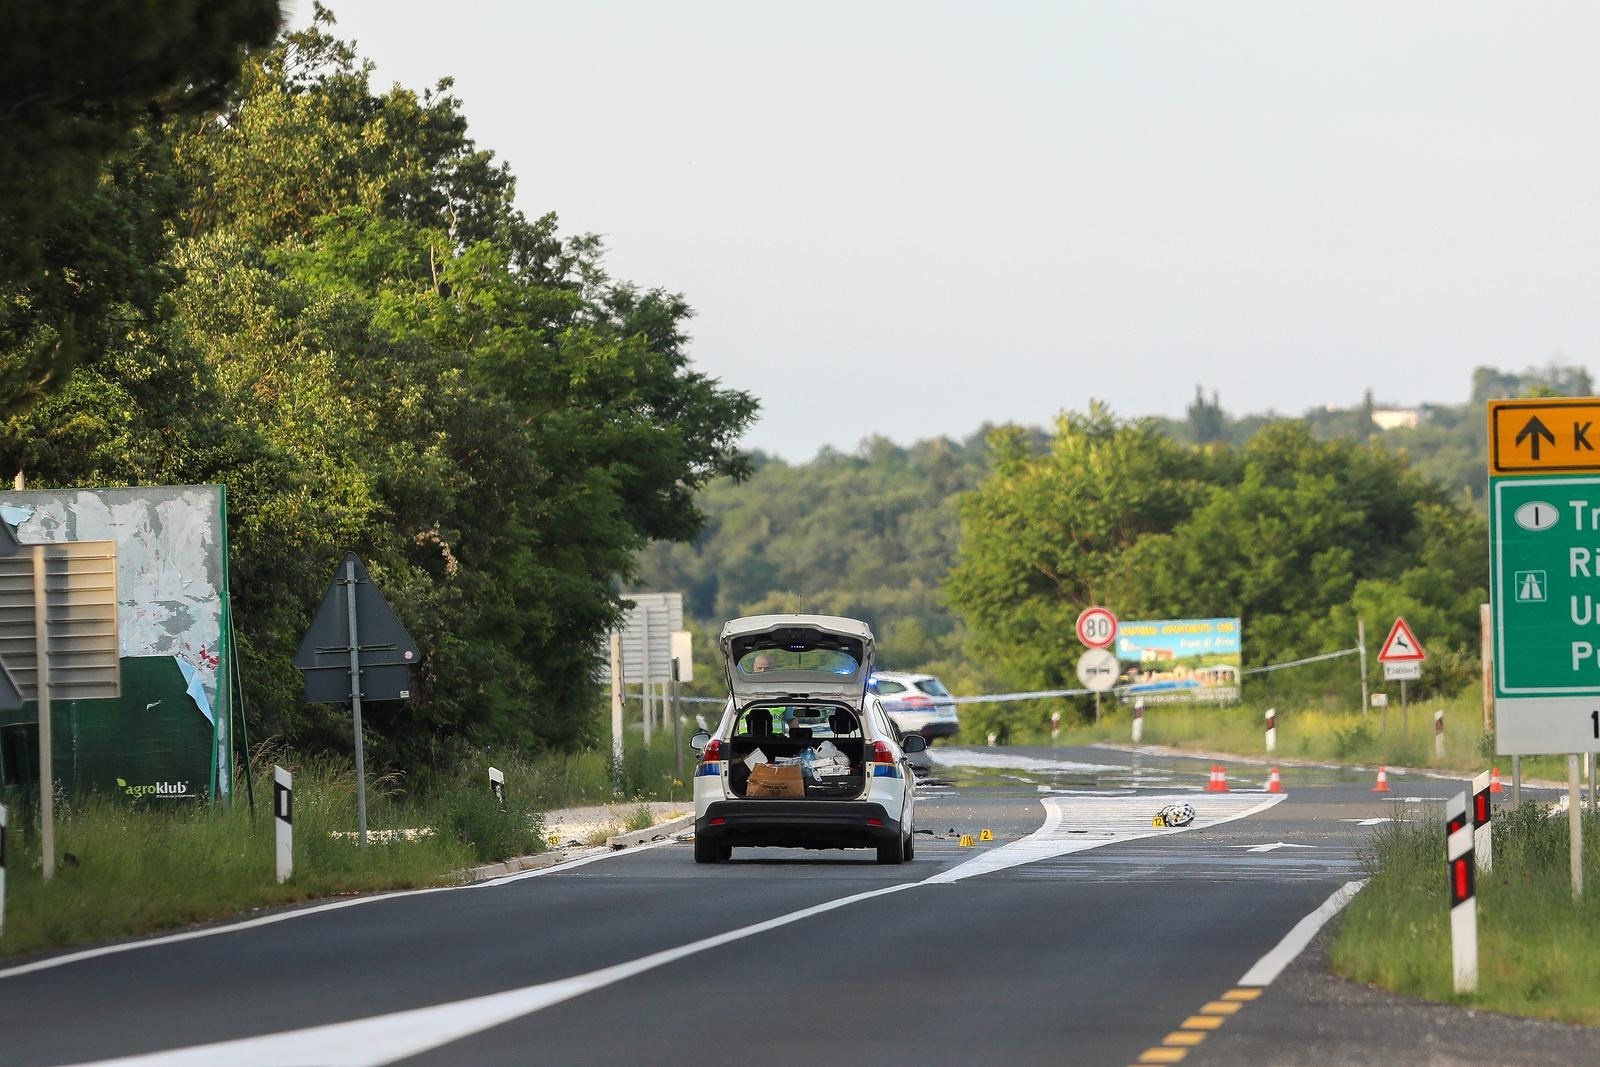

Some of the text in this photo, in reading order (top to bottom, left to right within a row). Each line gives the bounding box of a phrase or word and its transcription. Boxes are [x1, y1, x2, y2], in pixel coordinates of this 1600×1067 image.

[1086, 619, 1108, 637] 80
[1572, 641, 1600, 671] P
[125, 782, 187, 798] agroklub
[983, 830, 989, 839] 2
